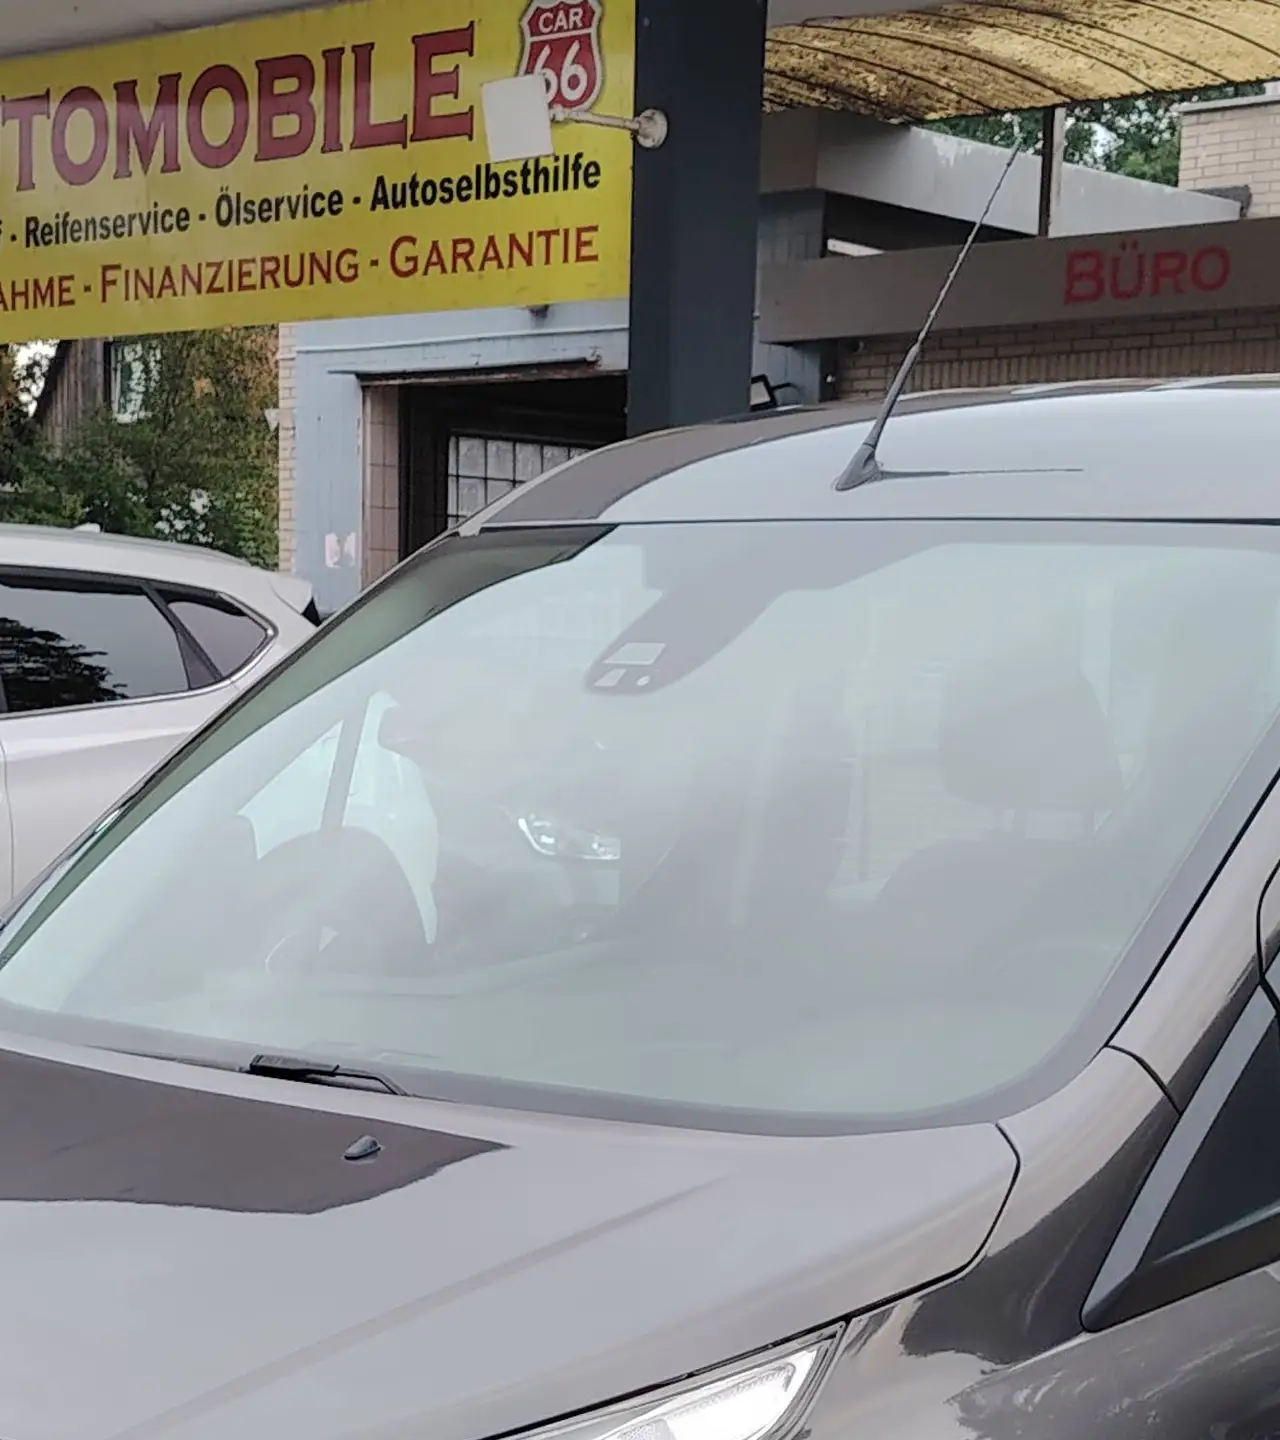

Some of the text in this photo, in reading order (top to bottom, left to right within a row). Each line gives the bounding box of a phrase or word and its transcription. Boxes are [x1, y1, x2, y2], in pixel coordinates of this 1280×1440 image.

[538, 7, 584, 34] CAR
[25, 202, 191, 248] Reifenservice
[215, 183, 344, 229] Ölservice
[369, 152, 601, 213] Autoselbsthilfe
[100, 248, 359, 303] FINANZIERUNG
[389, 225, 600, 279] GARANTIE
[1064, 240, 1232, 305] BÜRO
